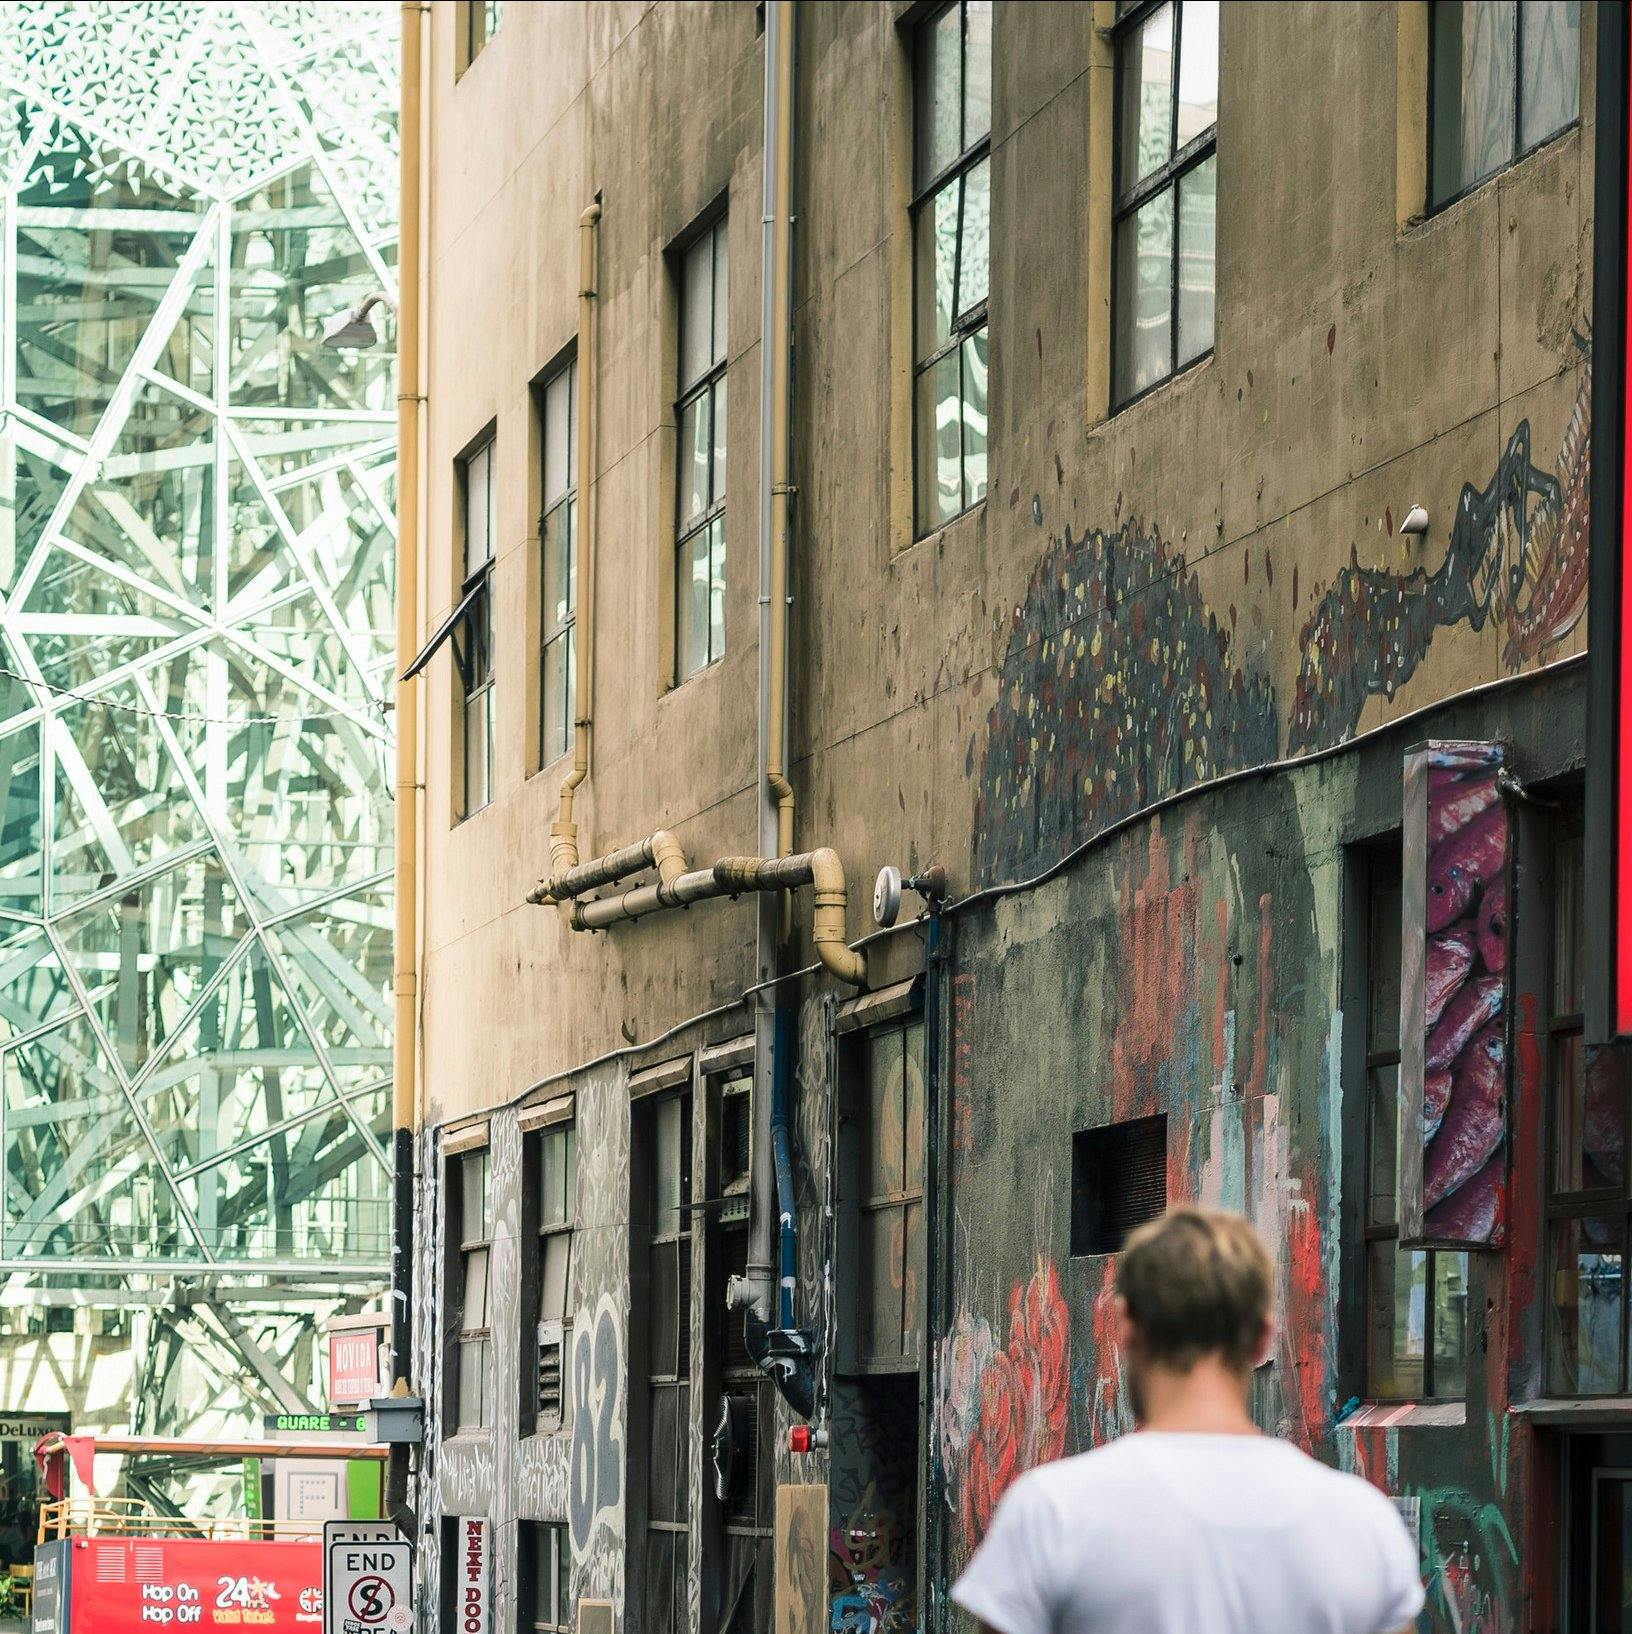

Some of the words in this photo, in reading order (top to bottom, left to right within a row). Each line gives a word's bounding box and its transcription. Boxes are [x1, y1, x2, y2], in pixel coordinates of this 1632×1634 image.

[277, 1415, 330, 1431] QUARE
[466, 1520, 484, 1582] NEXT
[346, 1553, 396, 1572] END
[142, 1583, 174, 1602] Hop
[177, 1583, 199, 1601] On
[216, 1576, 250, 1608] 24
[142, 1605, 174, 1623] Hop
[177, 1605, 203, 1622] Off
